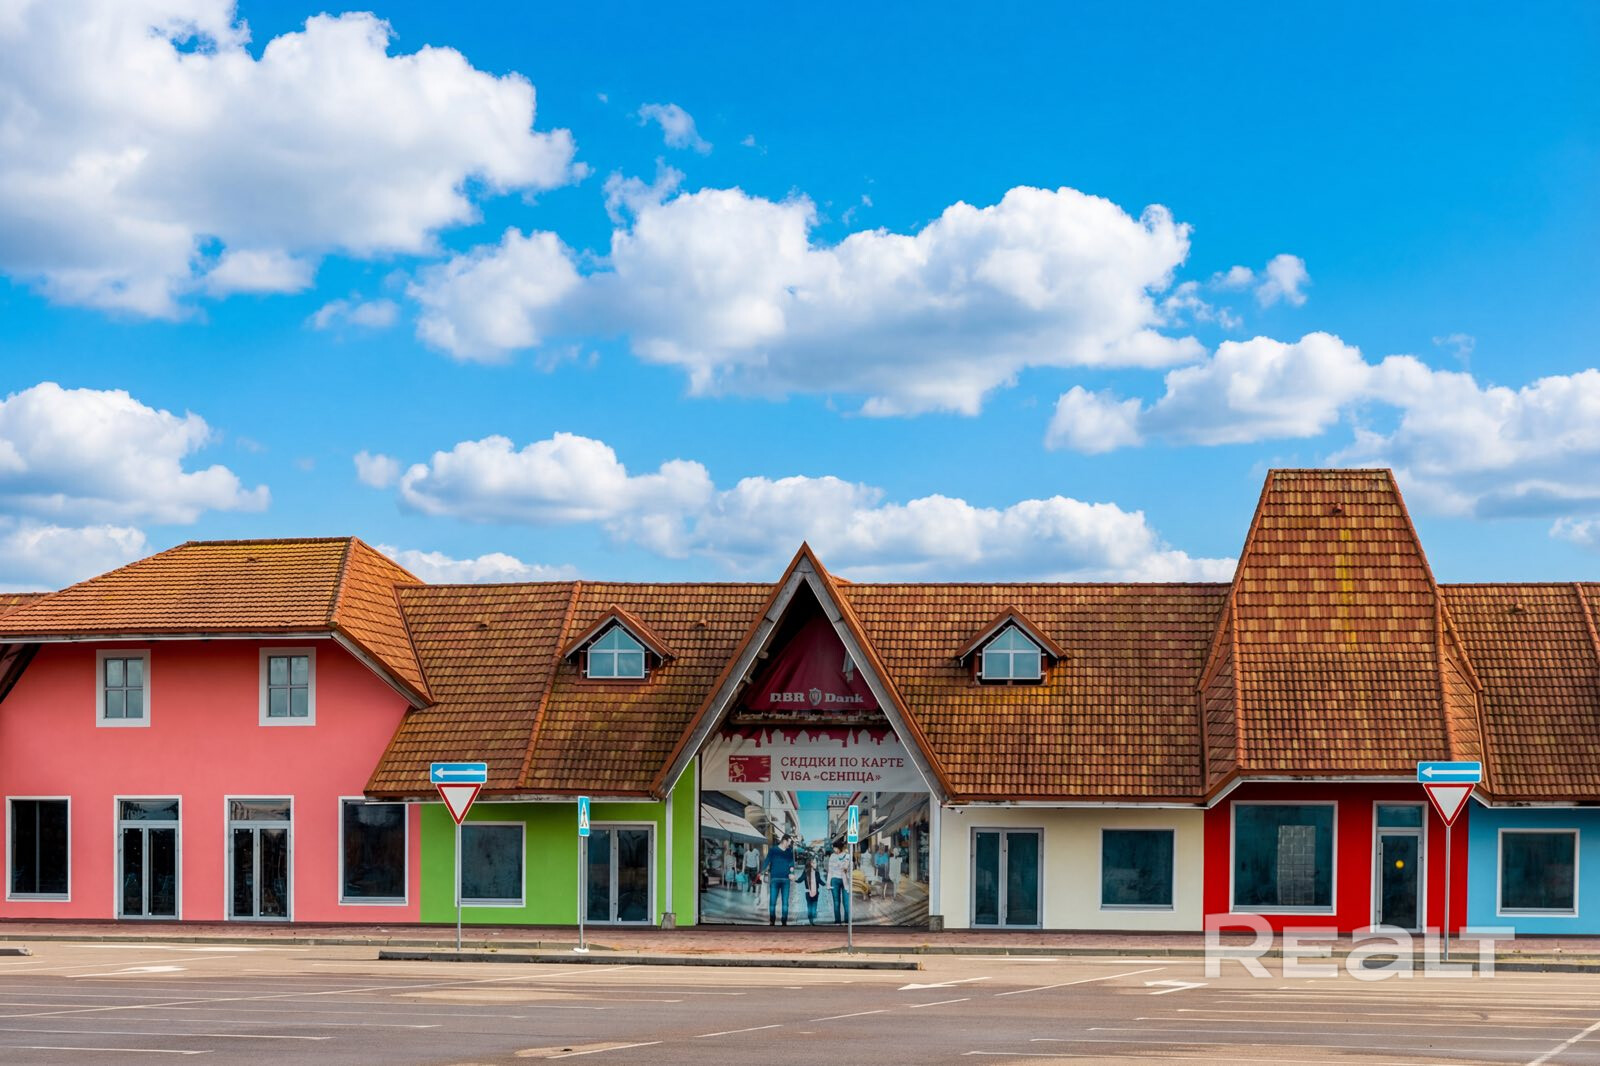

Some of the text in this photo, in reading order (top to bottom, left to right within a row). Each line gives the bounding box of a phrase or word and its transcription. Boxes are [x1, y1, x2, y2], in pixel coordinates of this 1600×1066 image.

[840, 757, 858, 768] ПО
[861, 757, 904, 768] КАРТЕ
[781, 771, 811, 781] VISA
